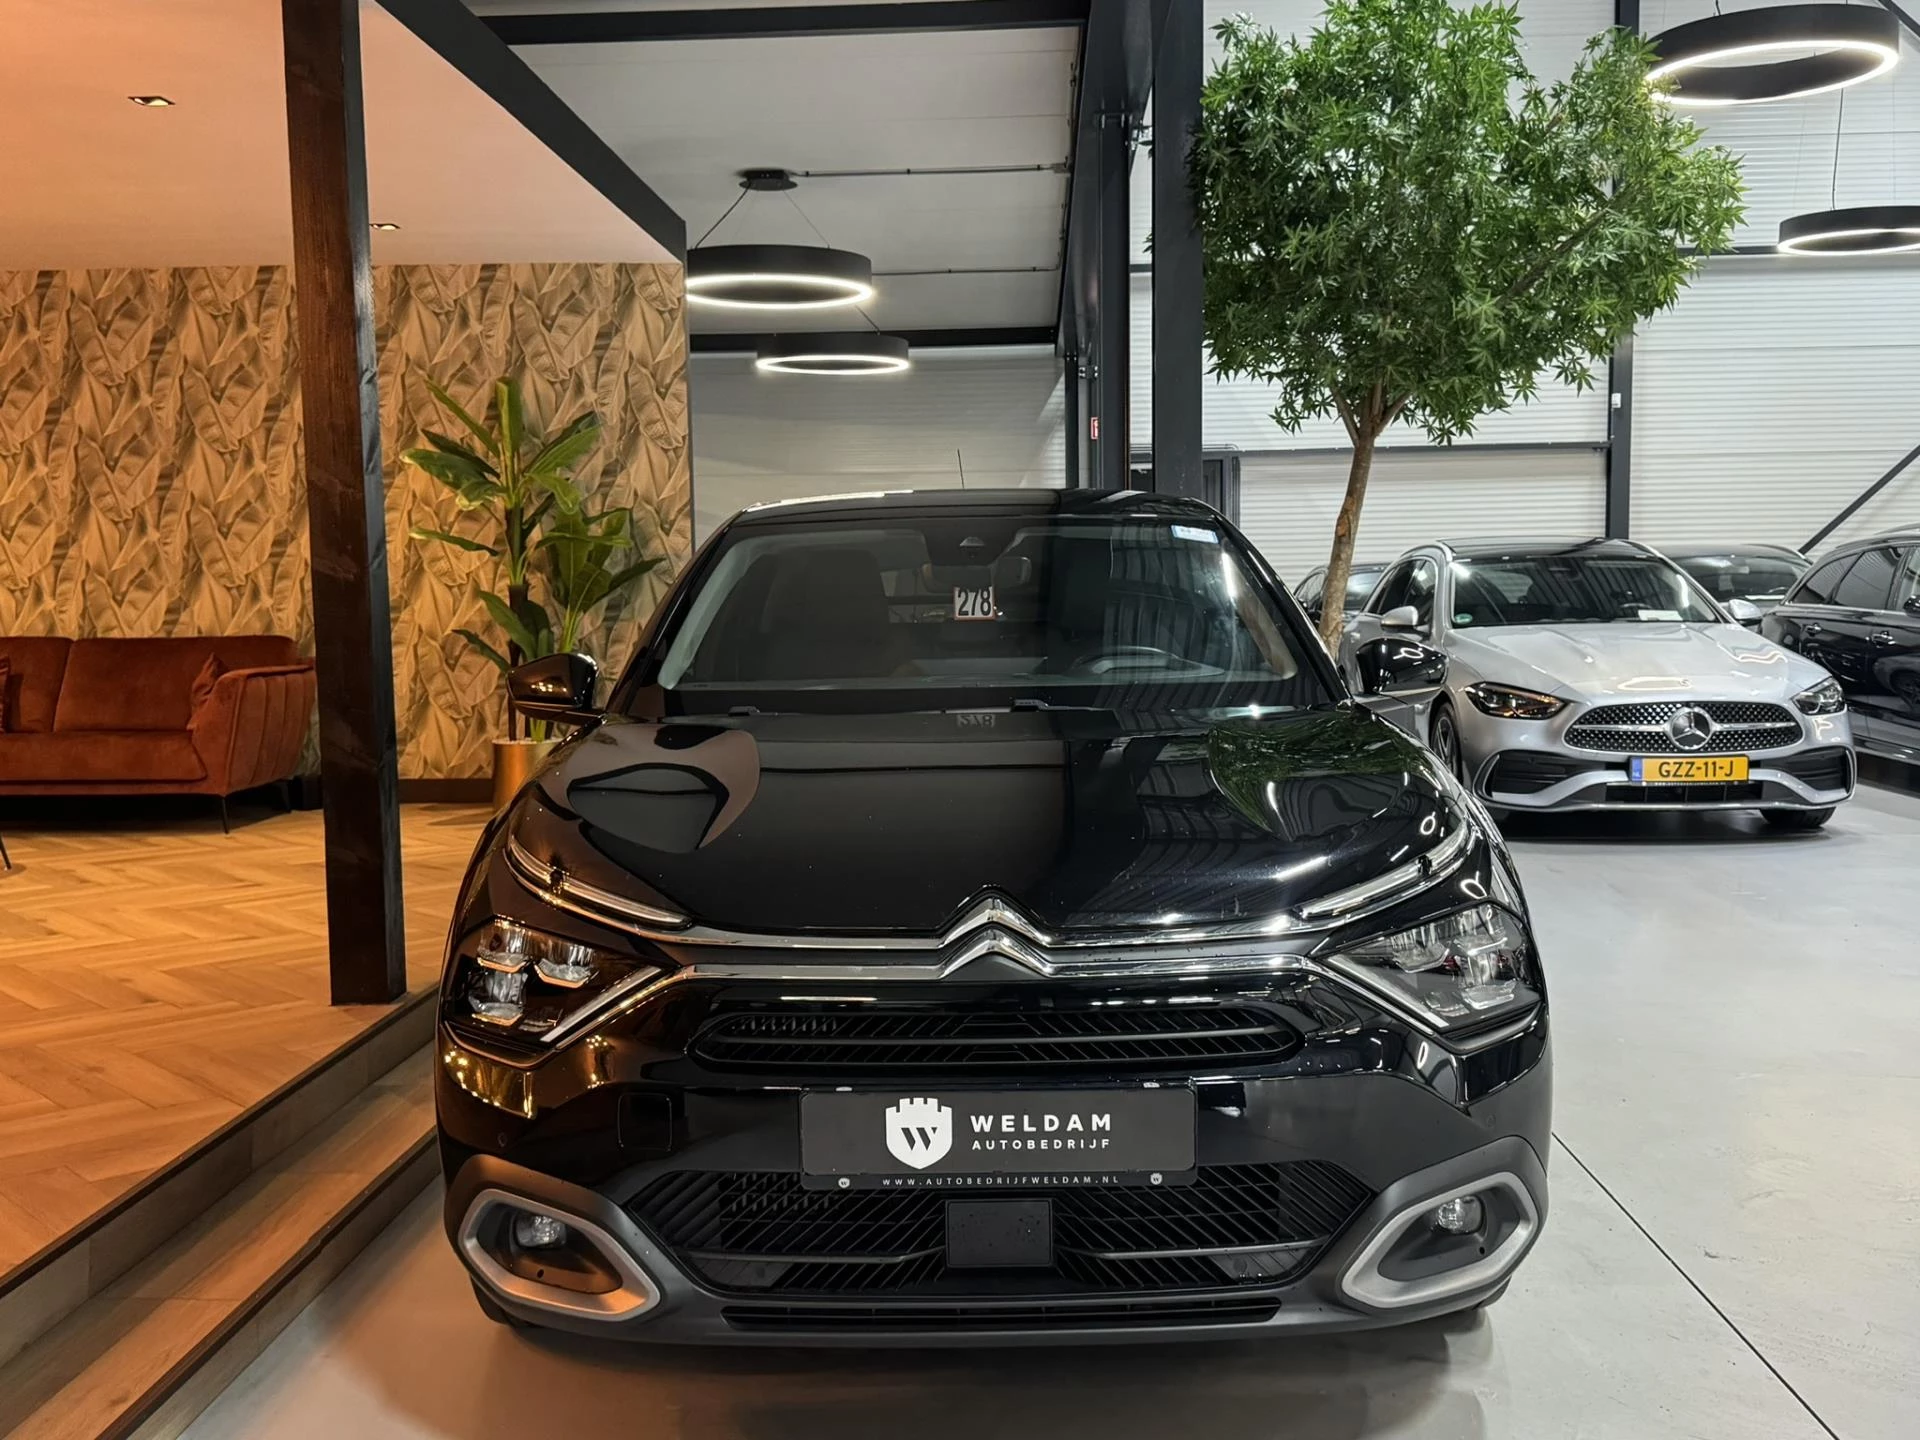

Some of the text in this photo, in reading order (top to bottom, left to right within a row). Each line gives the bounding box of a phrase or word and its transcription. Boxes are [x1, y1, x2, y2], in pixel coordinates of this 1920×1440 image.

[957, 588, 991, 616] 278
[1658, 760, 1734, 778] GZZ-11-J
[970, 1114, 1111, 1133] WELDAM
[972, 1139, 1110, 1151] AUTOBEDRIJF
[882, 1176, 1119, 1186] WWW.AUTOBEDRIJFWELDAM.NL
